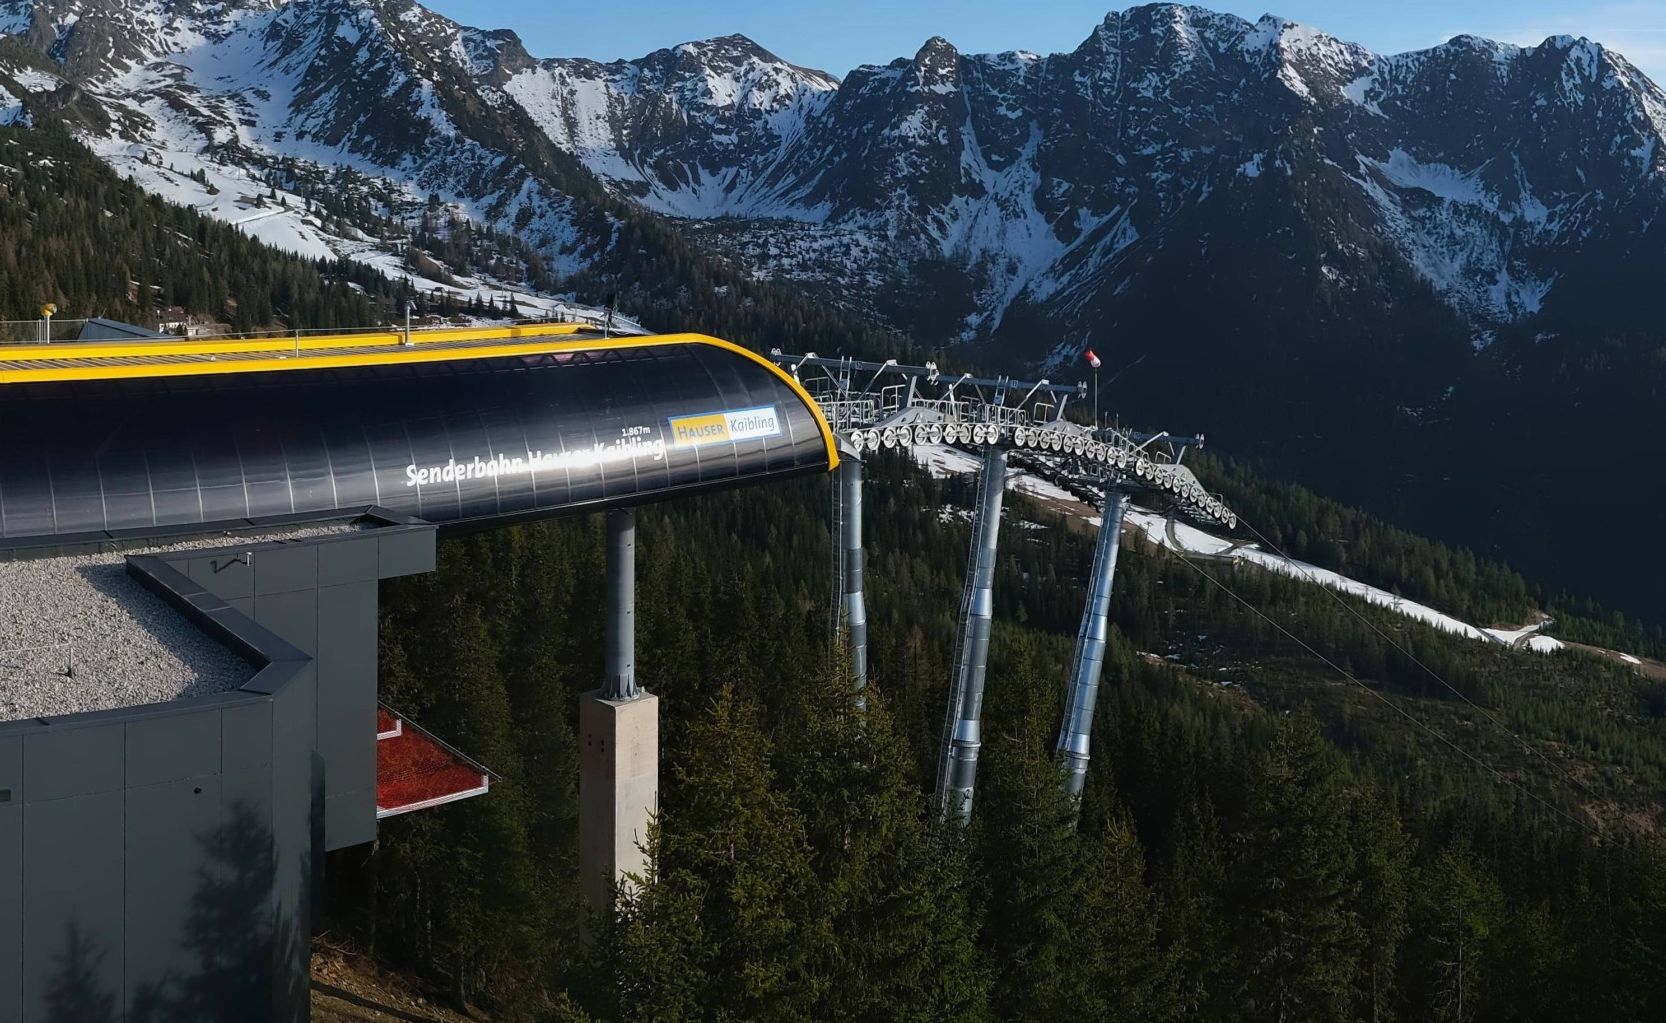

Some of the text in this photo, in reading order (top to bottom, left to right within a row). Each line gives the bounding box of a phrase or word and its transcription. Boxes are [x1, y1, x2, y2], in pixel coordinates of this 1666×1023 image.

[621, 425, 651, 437] 1.867m
[677, 415, 775, 440] HAUSER Kaibling
[406, 453, 523, 487] Senderbahn
[593, 436, 664, 461] Kaibling
